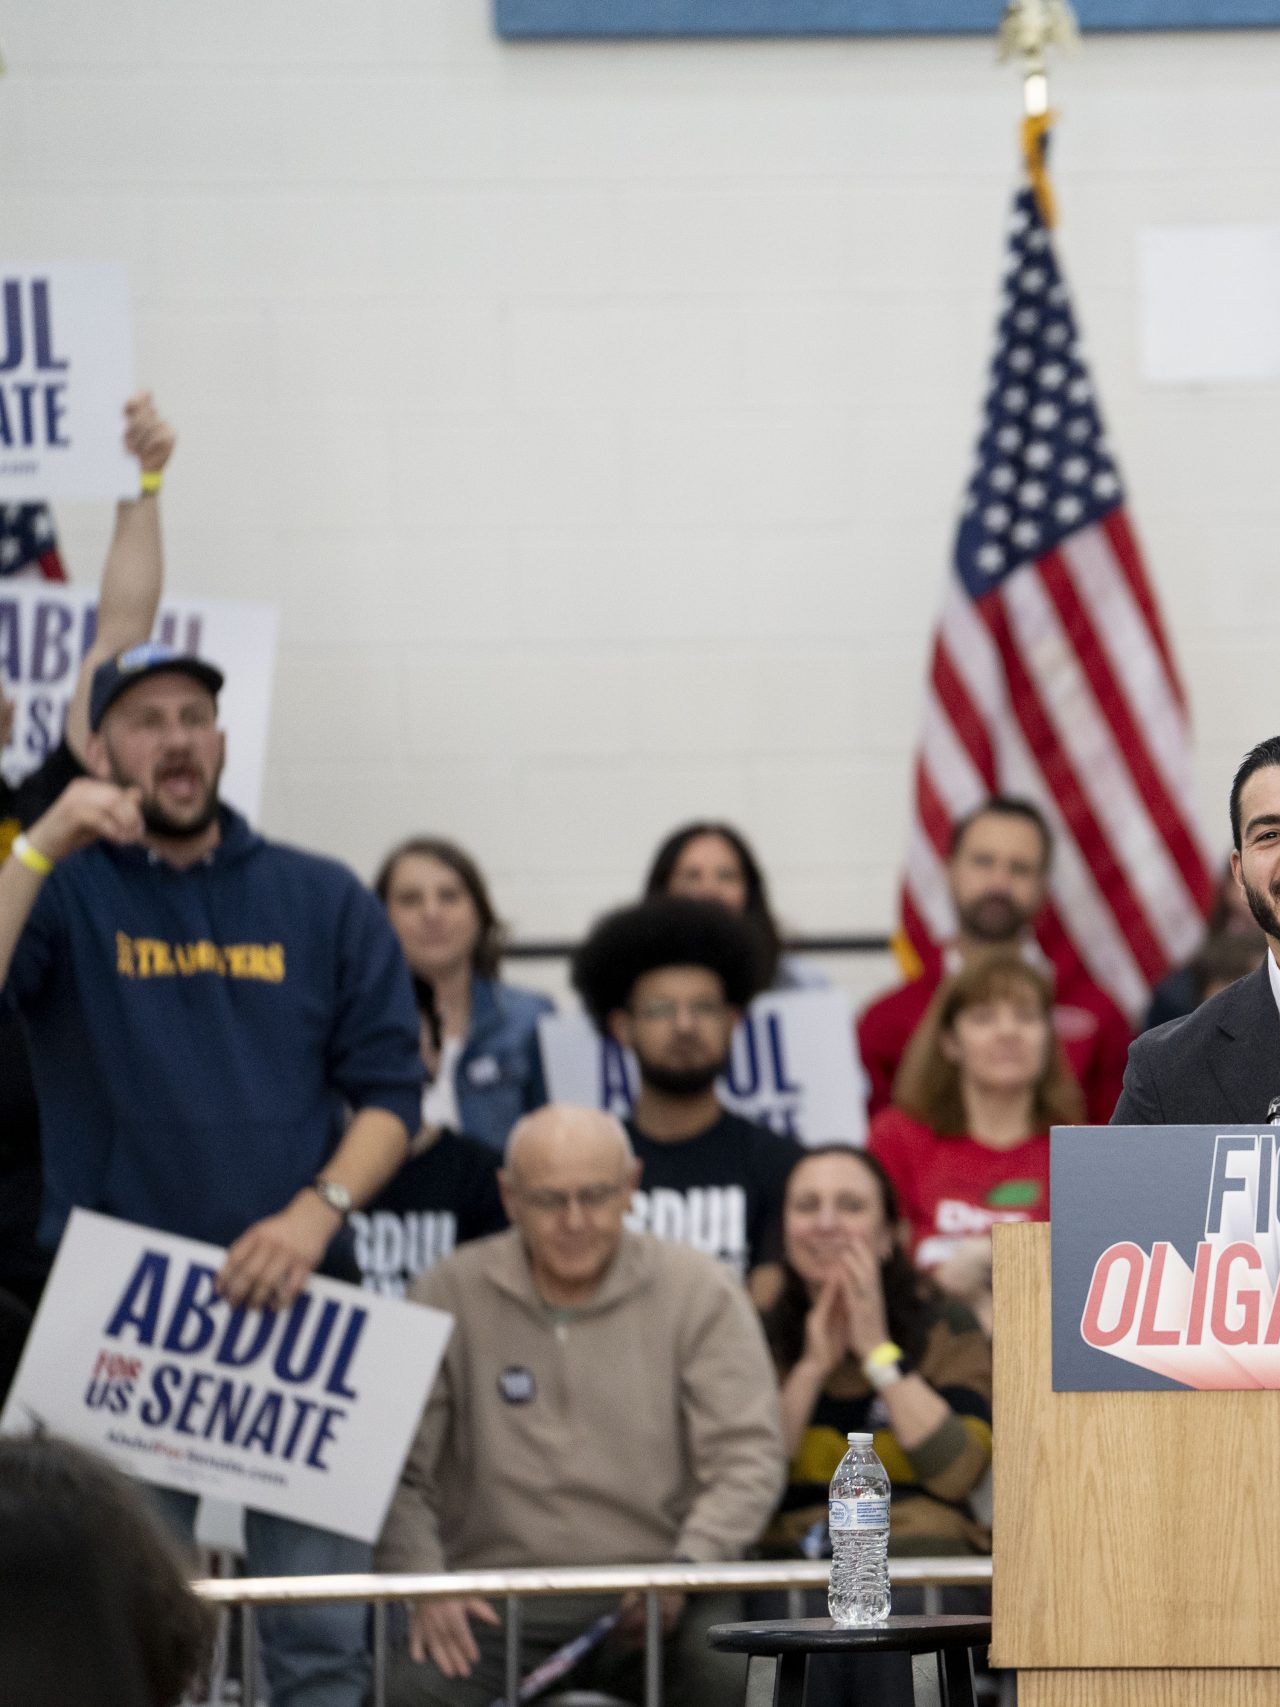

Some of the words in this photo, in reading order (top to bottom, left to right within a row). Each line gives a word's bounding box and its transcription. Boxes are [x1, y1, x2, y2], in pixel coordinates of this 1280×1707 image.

[106, 1248, 369, 1400] ABDUL
[85, 1377, 135, 1414] US
[139, 1364, 347, 1472] SENATE
